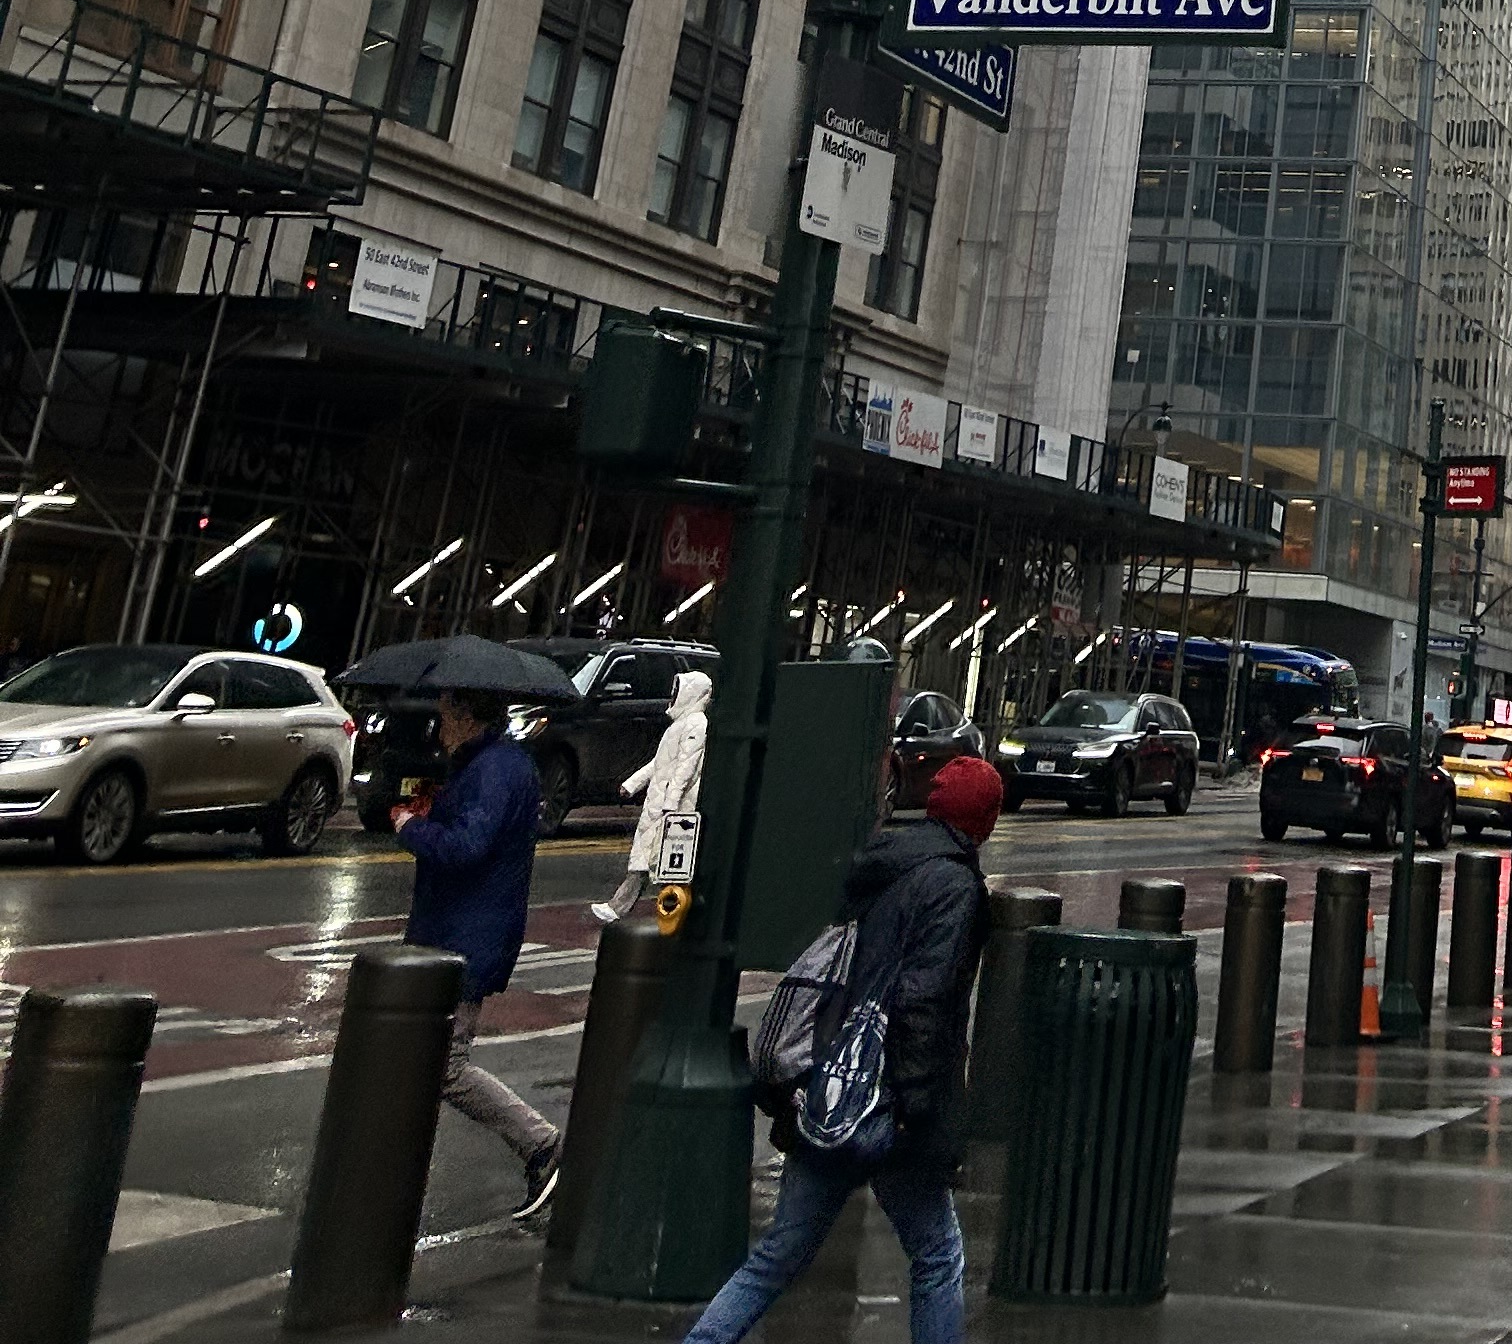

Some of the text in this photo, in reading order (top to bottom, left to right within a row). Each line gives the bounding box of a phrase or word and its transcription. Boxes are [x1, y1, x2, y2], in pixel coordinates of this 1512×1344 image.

[983, 54, 1005, 100] St
[825, 107, 891, 148] Grand Central
[820, 132, 867, 168] Madison
